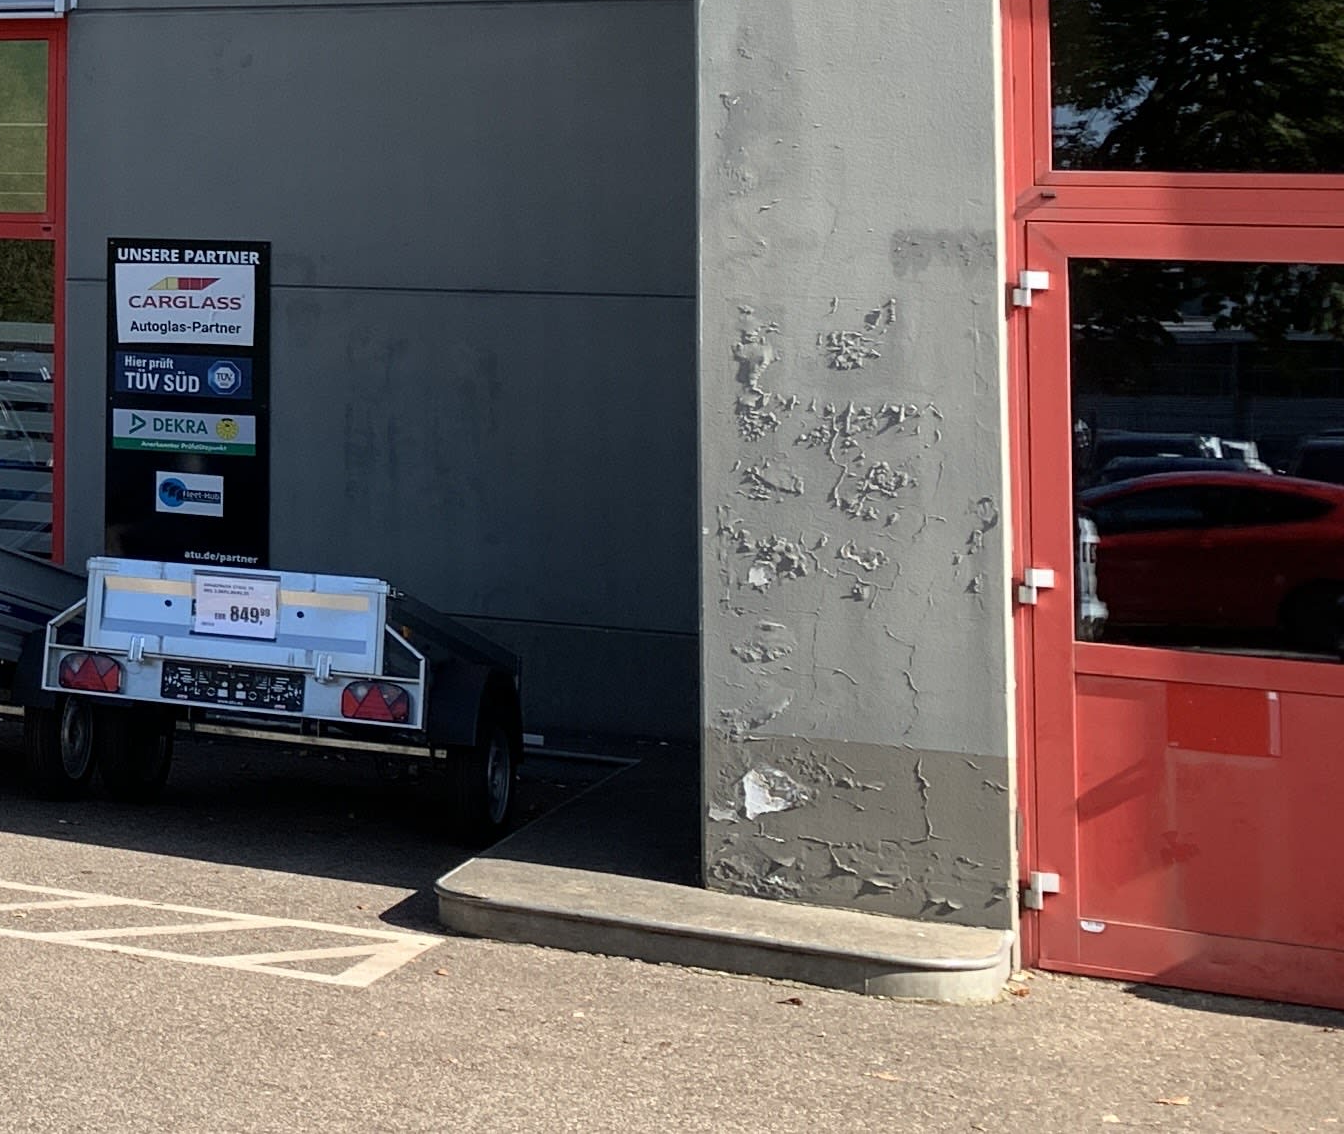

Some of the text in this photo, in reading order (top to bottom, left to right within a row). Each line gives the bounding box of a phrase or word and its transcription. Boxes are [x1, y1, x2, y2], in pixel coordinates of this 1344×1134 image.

[117, 248, 260, 265] UNSERE PARTNER
[128, 295, 242, 310] CARGLASS
[130, 320, 242, 335] Autoglas-Partner
[124, 355, 174, 370] Hier prüft
[124, 369, 200, 393] TÜV SÜD
[153, 418, 208, 434] DEKRA
[184, 551, 259, 564] atu.de/partner
